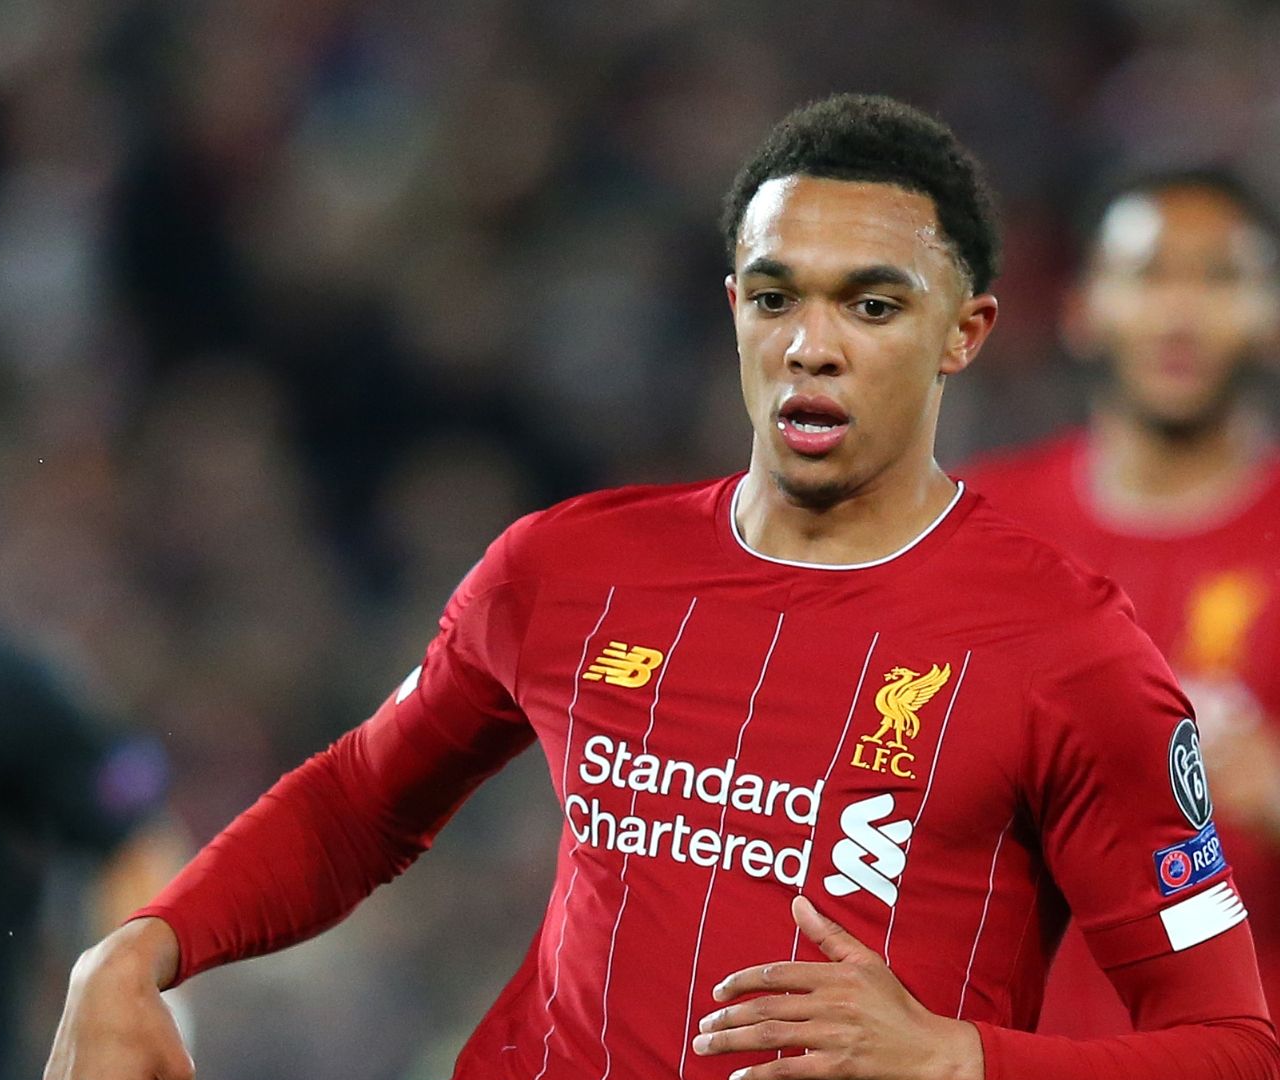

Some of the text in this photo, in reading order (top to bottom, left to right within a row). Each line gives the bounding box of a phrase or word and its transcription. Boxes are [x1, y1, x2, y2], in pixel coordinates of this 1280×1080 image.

[579, 736, 824, 827] Standard
[850, 743, 917, 779] L.F.C.
[1193, 772, 1202, 799] 6
[565, 794, 813, 888] Chartered
